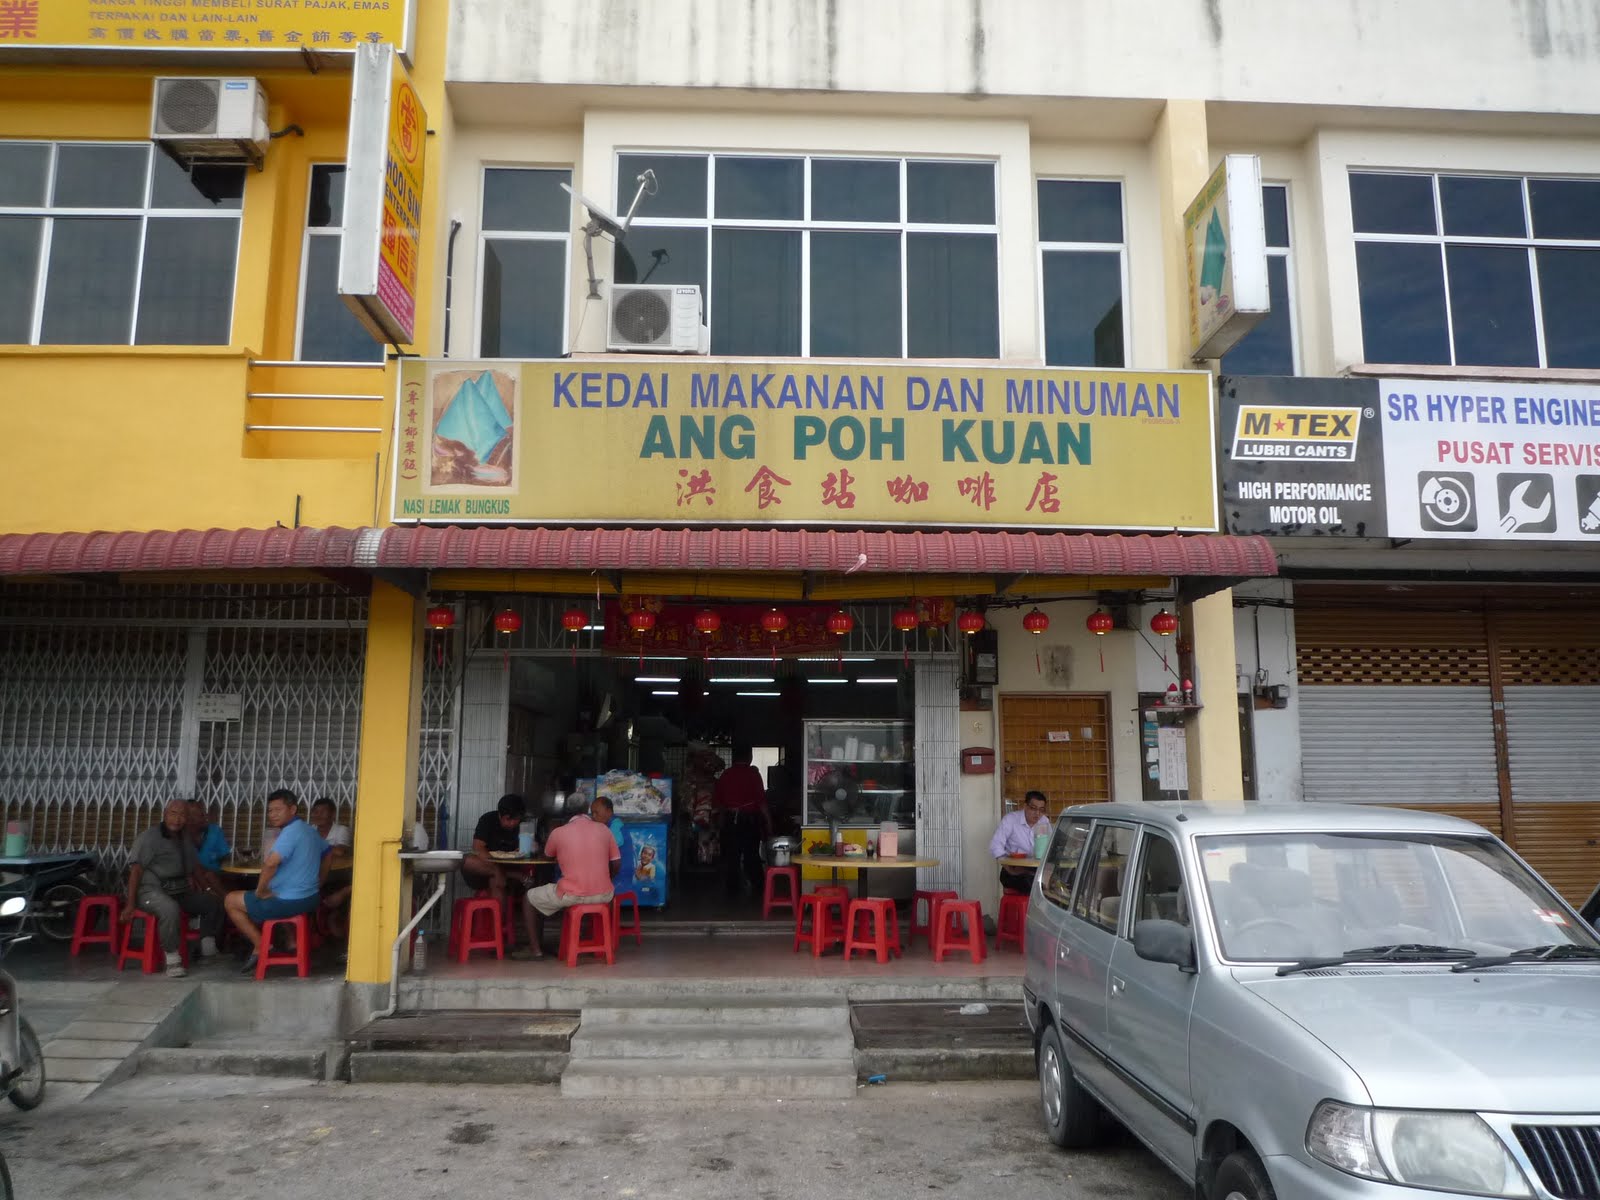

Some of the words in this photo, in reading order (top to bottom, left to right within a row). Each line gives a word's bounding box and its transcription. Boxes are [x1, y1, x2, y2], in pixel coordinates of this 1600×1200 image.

[191, 0, 249, 8] MEMBELI
[256, 0, 299, 9] SURAT
[353, 1, 390, 10] EMAS
[88, 11, 156, 21] TERPAKAI
[160, 13, 187, 22] DAN
[193, 14, 258, 23] LAIN-LAIN
[553, 373, 669, 409] KEDAI
[691, 374, 884, 411] MAKANAN
[907, 376, 984, 413] DAN
[1005, 379, 1181, 418] MINUMAN
[1387, 393, 1420, 422] SR
[1426, 394, 1506, 424] HYPER
[1514, 397, 1600, 428] ENGINE
[639, 415, 756, 461] ANG
[793, 415, 906, 461] POH
[942, 418, 1092, 466] KUAN
[1243, 444, 1290, 456] LUBRI
[1294, 445, 1347, 457] CANTS
[1437, 440, 1514, 465] PUSAT
[676, 465, 1061, 513] 洪食站咖啡店
[1238, 481, 1271, 499] HIGH
[1274, 482, 1372, 501] PERFORMANCE
[403, 499, 425, 515] NASI
[429, 499, 461, 515] LEMAK
[465, 499, 511, 515] BUNGKUS
[1269, 505, 1317, 524] MOTOR
[1319, 506, 1342, 524] OIL
